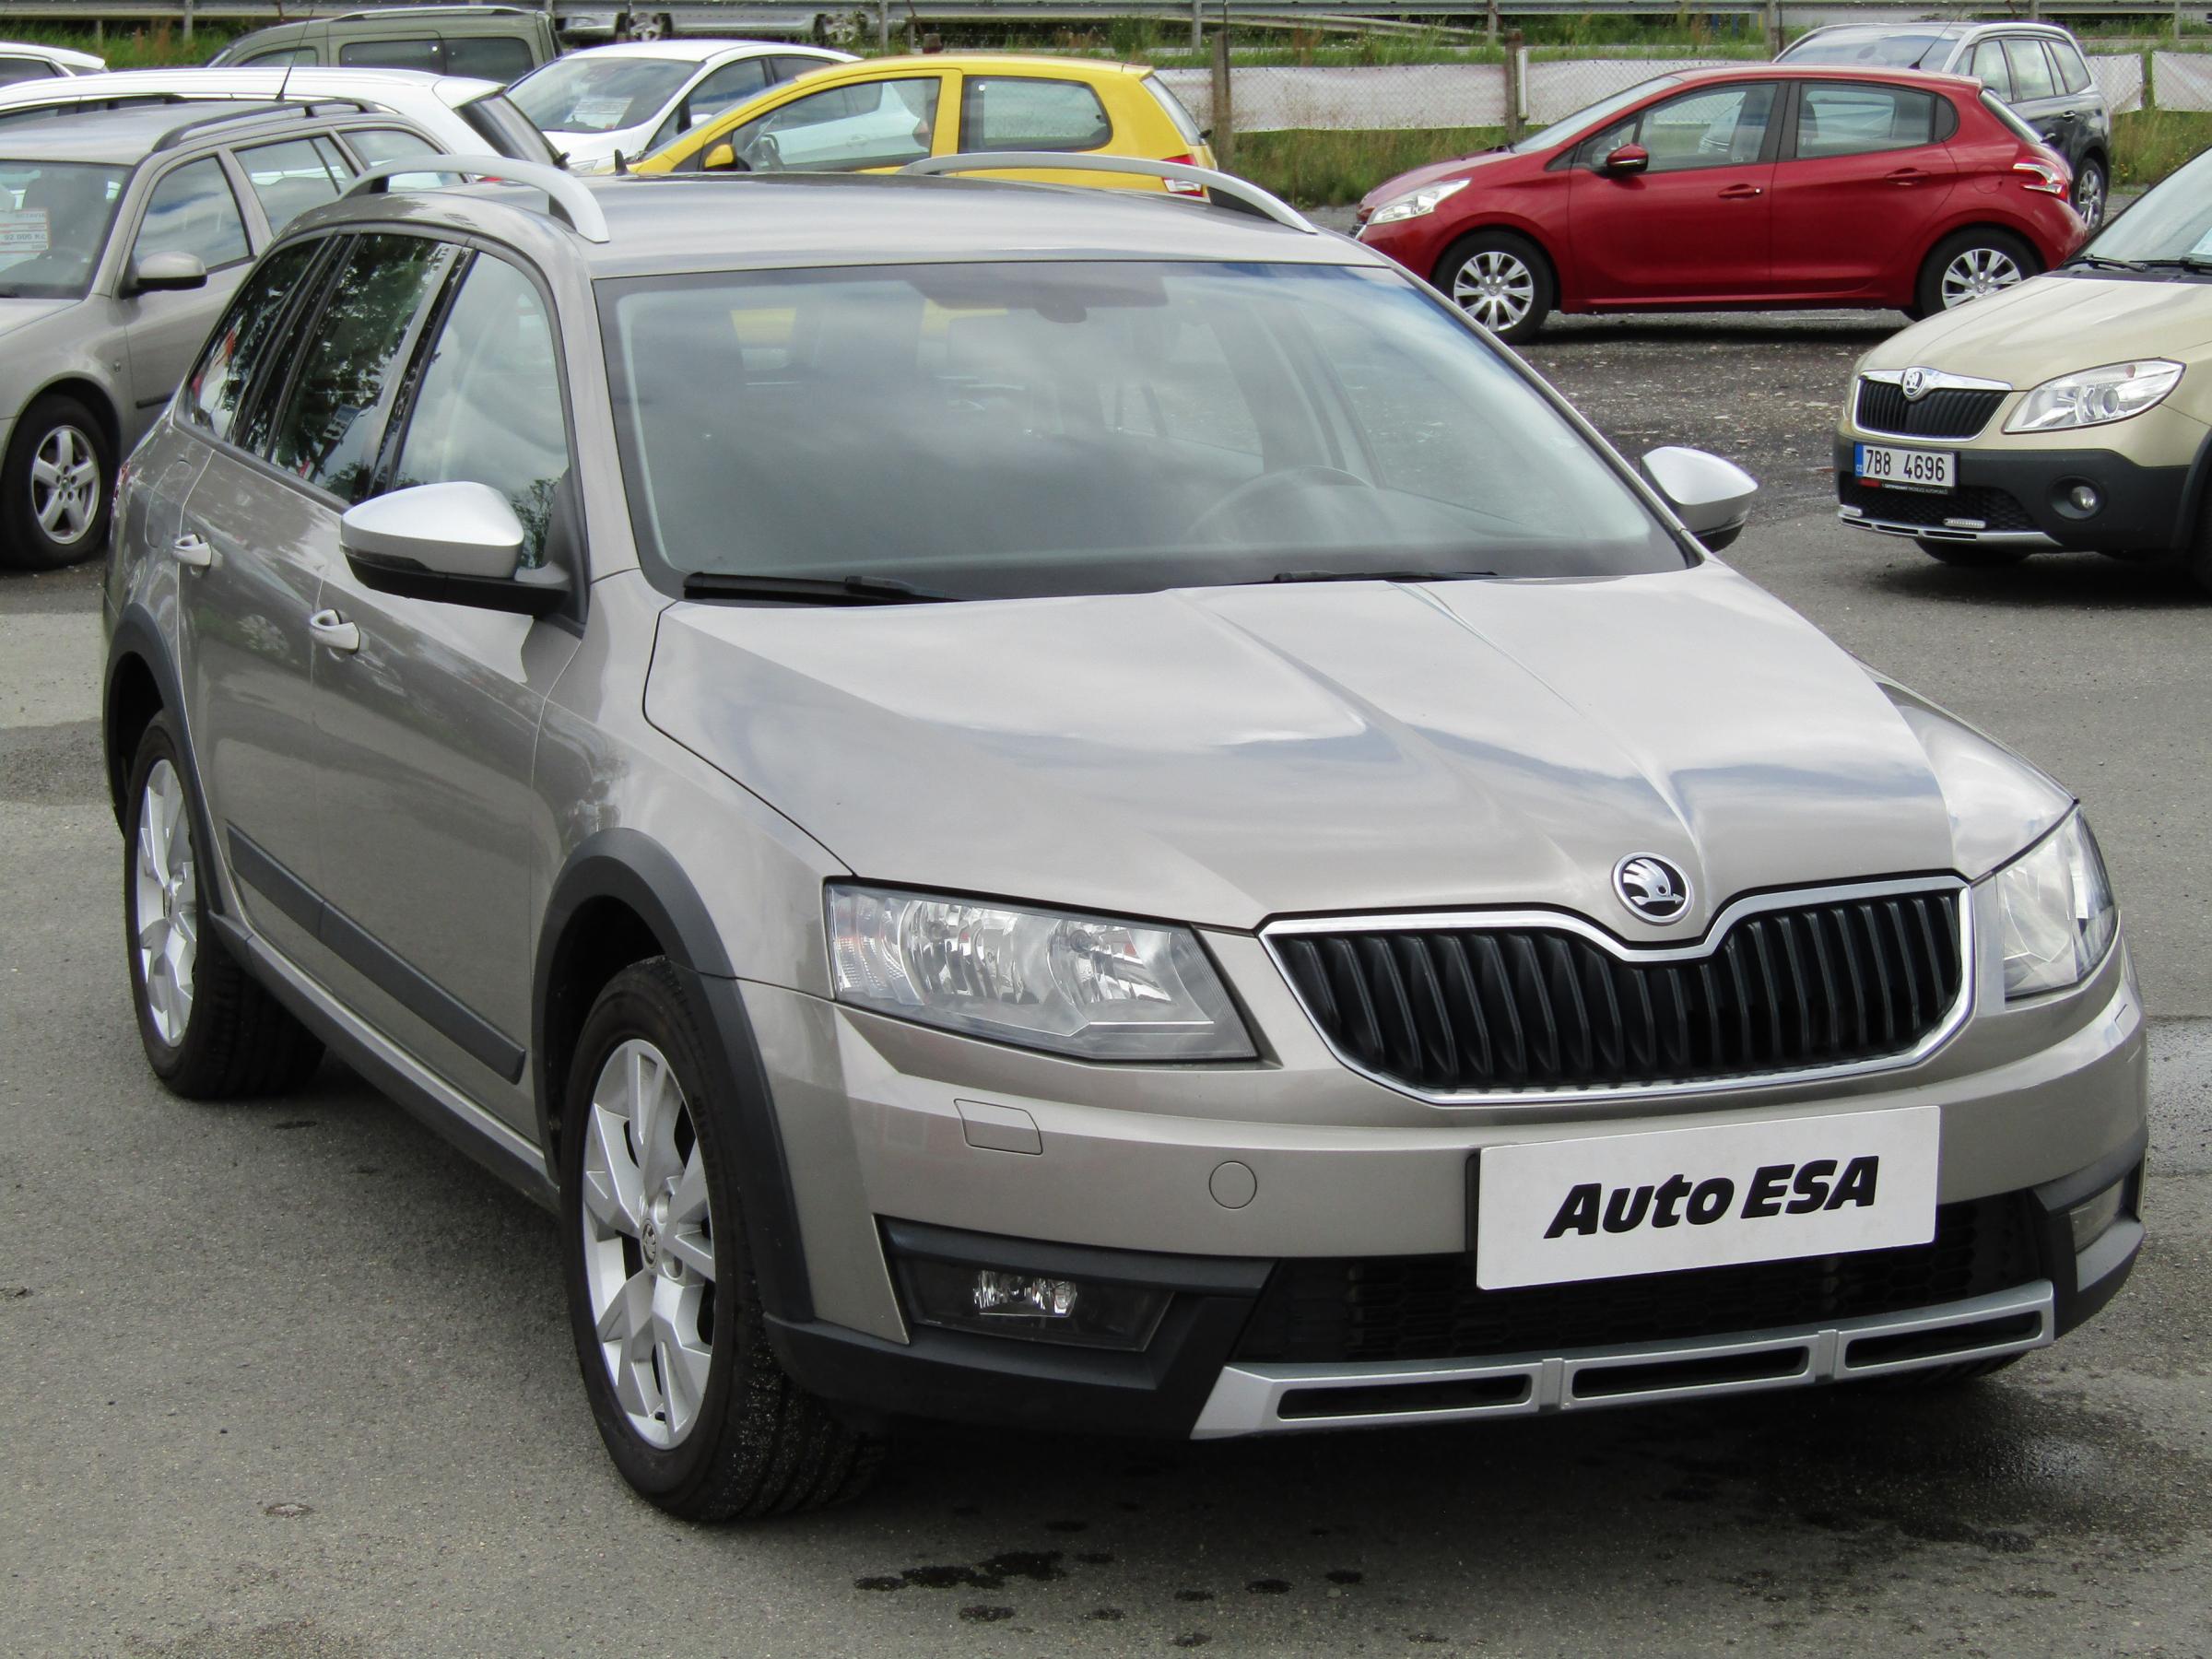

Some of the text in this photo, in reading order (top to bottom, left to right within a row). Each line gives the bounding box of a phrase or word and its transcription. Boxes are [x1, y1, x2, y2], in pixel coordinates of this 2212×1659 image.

[1866, 449, 1945, 482] 7B8 4696
[1544, 1155, 1879, 1240] Auto ESA
